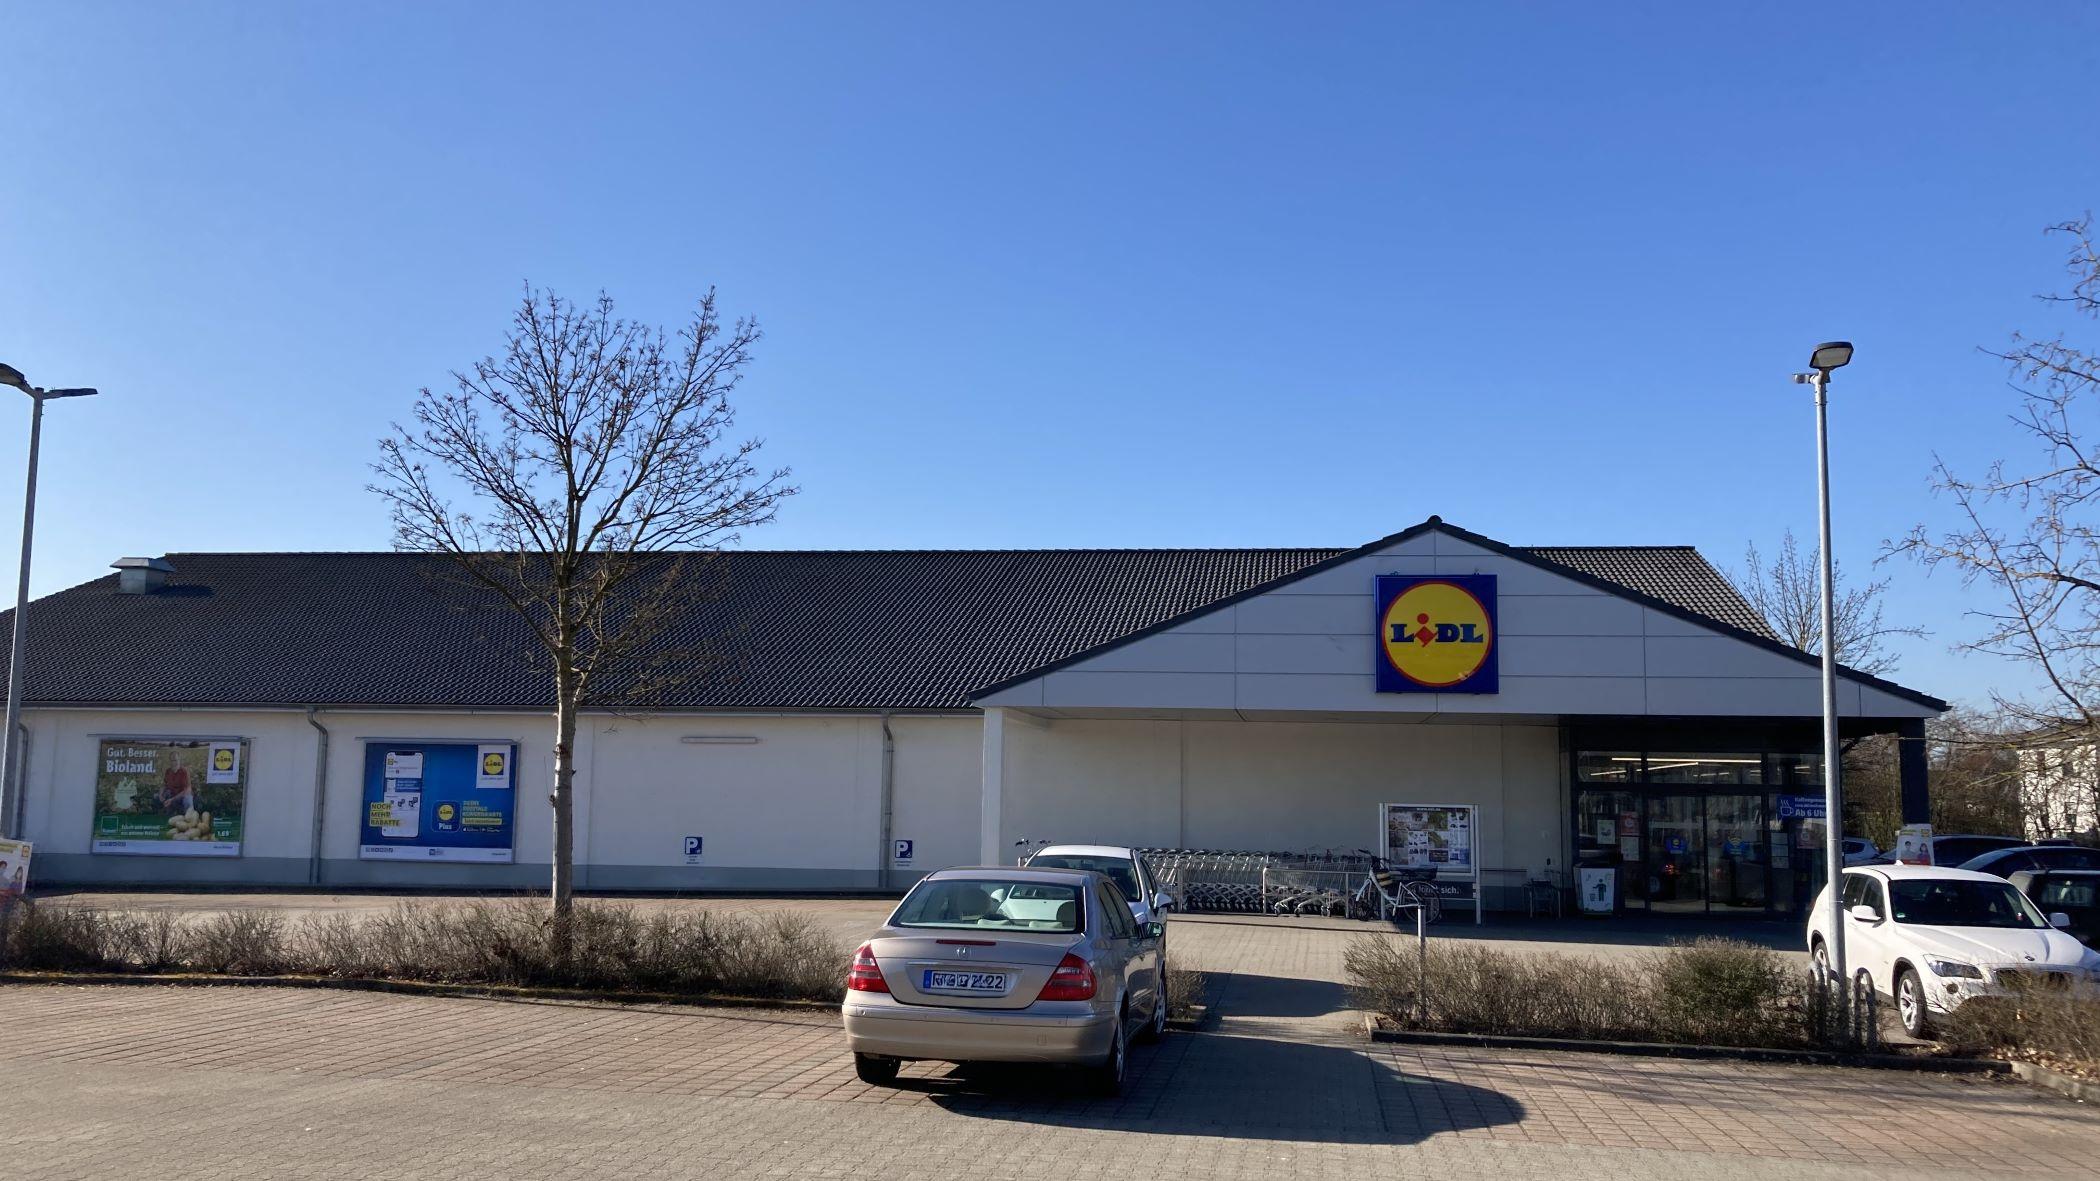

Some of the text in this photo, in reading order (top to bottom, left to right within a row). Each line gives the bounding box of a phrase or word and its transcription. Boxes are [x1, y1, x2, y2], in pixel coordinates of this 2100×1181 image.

[107, 747, 158, 758] Gut. Besser.
[106, 759, 156, 773] Bioland.
[438, 822, 452, 830] Plus
[1441, 885, 1460, 894] sich.
